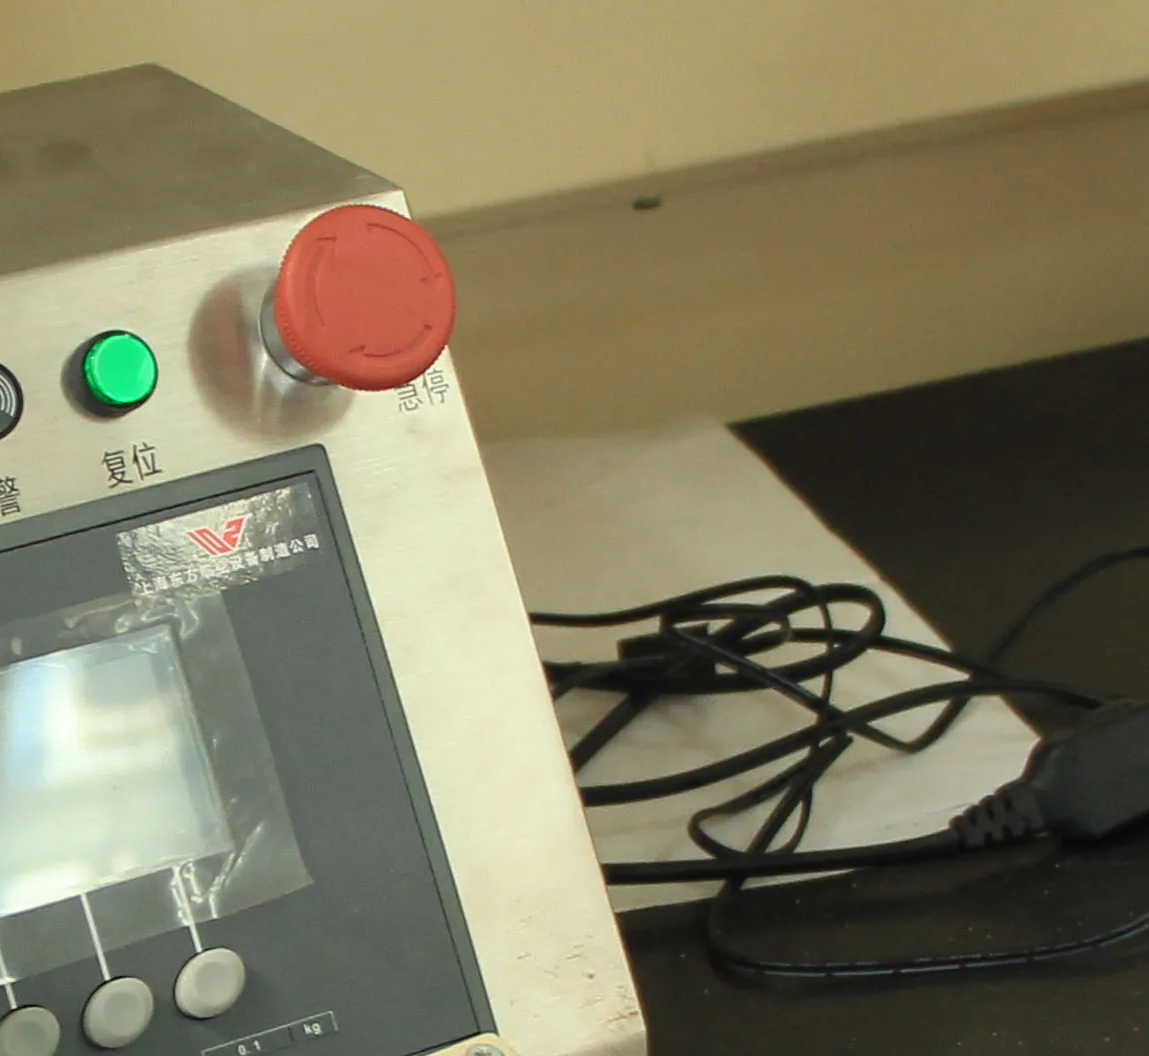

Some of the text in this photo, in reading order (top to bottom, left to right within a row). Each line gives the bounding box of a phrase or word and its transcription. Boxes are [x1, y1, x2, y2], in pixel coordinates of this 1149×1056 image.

[397, 367, 449, 412] 急停
[101, 441, 164, 489] 复位
[237, 1040, 262, 1056] 0.1
[303, 1021, 323, 1035] kg
